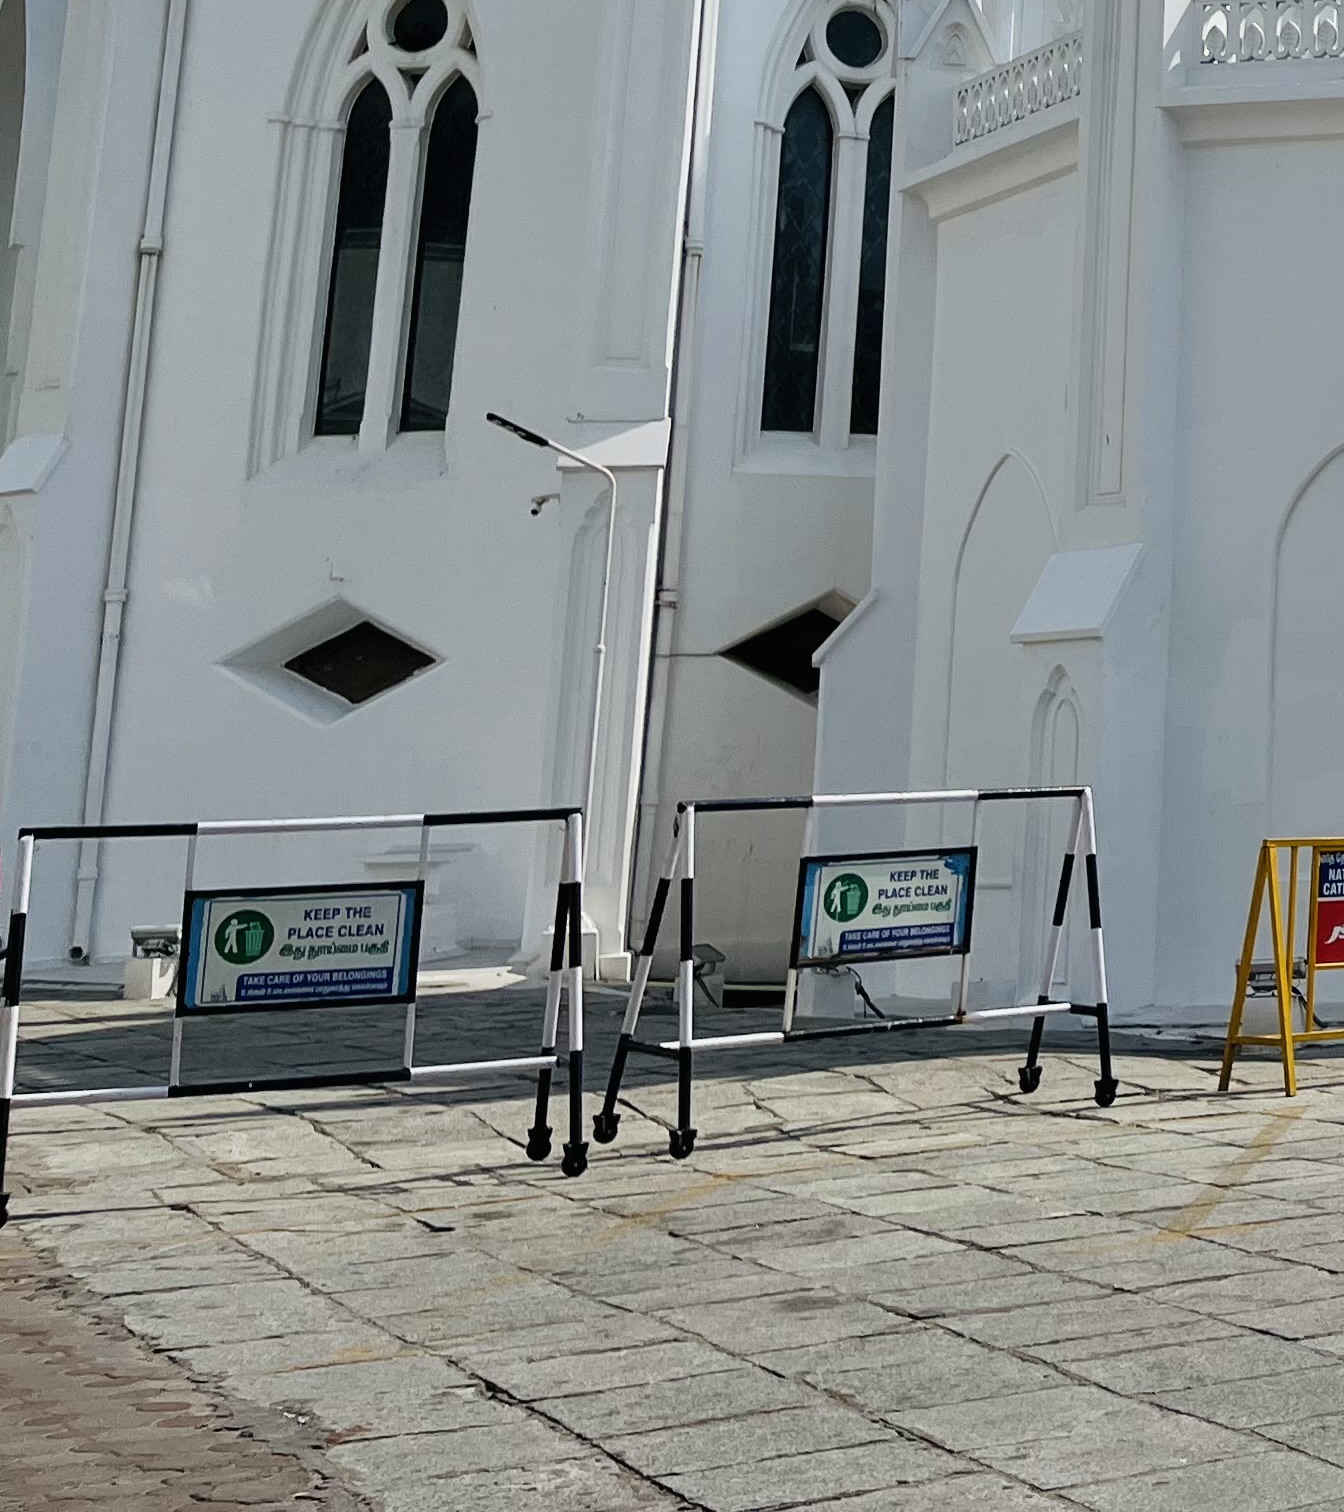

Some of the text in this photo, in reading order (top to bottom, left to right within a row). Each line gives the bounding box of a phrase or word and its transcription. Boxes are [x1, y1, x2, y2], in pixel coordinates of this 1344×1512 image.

[889, 868, 940, 883] KEEP THE
[877, 884, 949, 900] PLACE CLEAN
[303, 905, 372, 922] KEEP THE
[287, 923, 385, 940] PLACE CLEAN
[243, 969, 388, 986] TAKE CARE OF YOUR BELONGINGS
